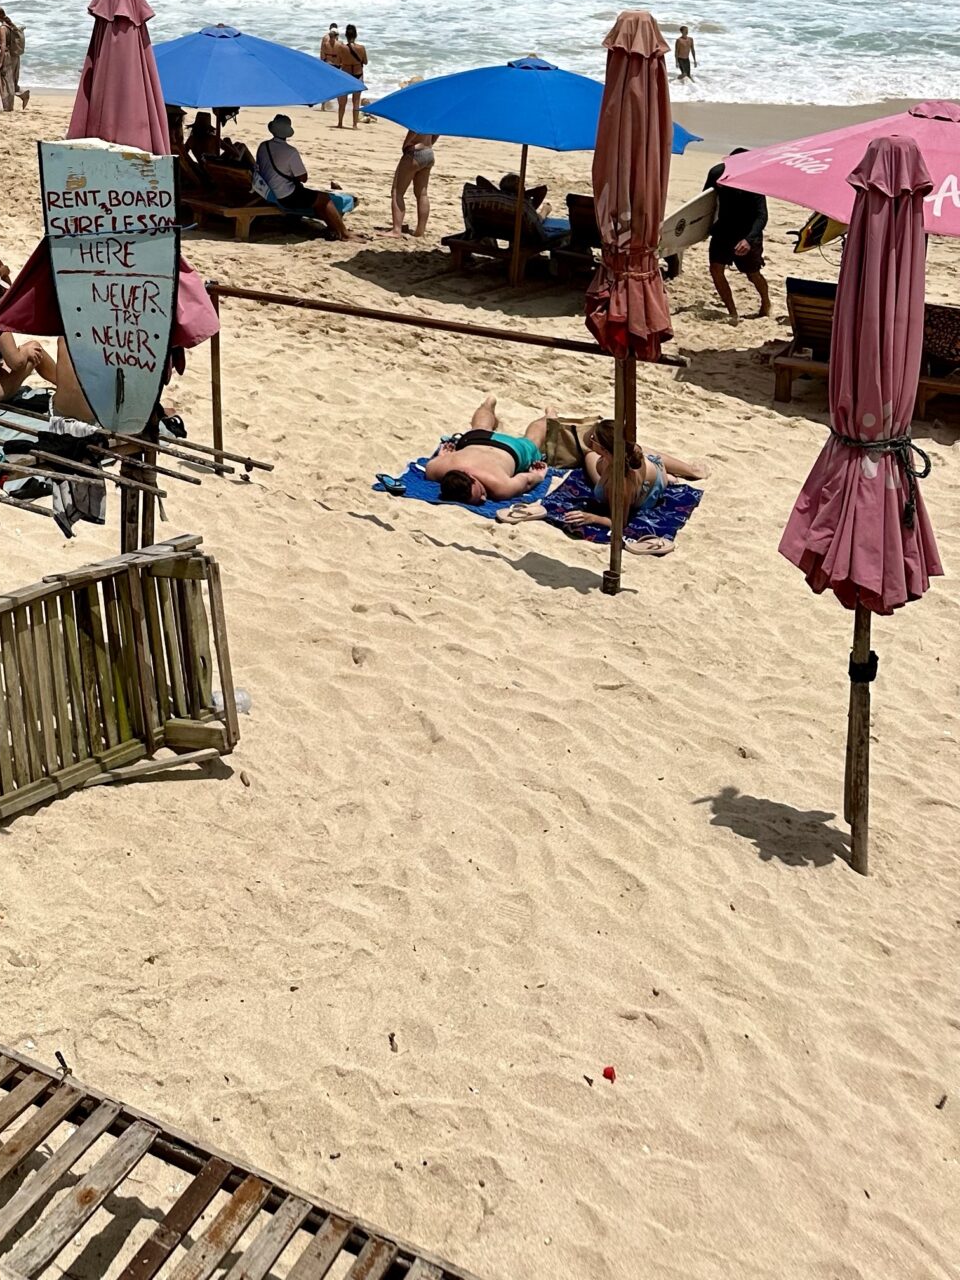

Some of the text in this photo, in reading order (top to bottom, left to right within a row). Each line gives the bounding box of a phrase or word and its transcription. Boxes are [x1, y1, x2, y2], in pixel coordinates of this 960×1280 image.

[47, 190, 172, 211] RENT BOARD
[50, 214, 178, 238] SURF LESSON
[80, 237, 136, 268] HERE
[92, 280, 167, 317] NEVER
[110, 308, 142, 326] TRY
[92, 325, 156, 359] NEVER
[103, 347, 156, 373] KNOW
